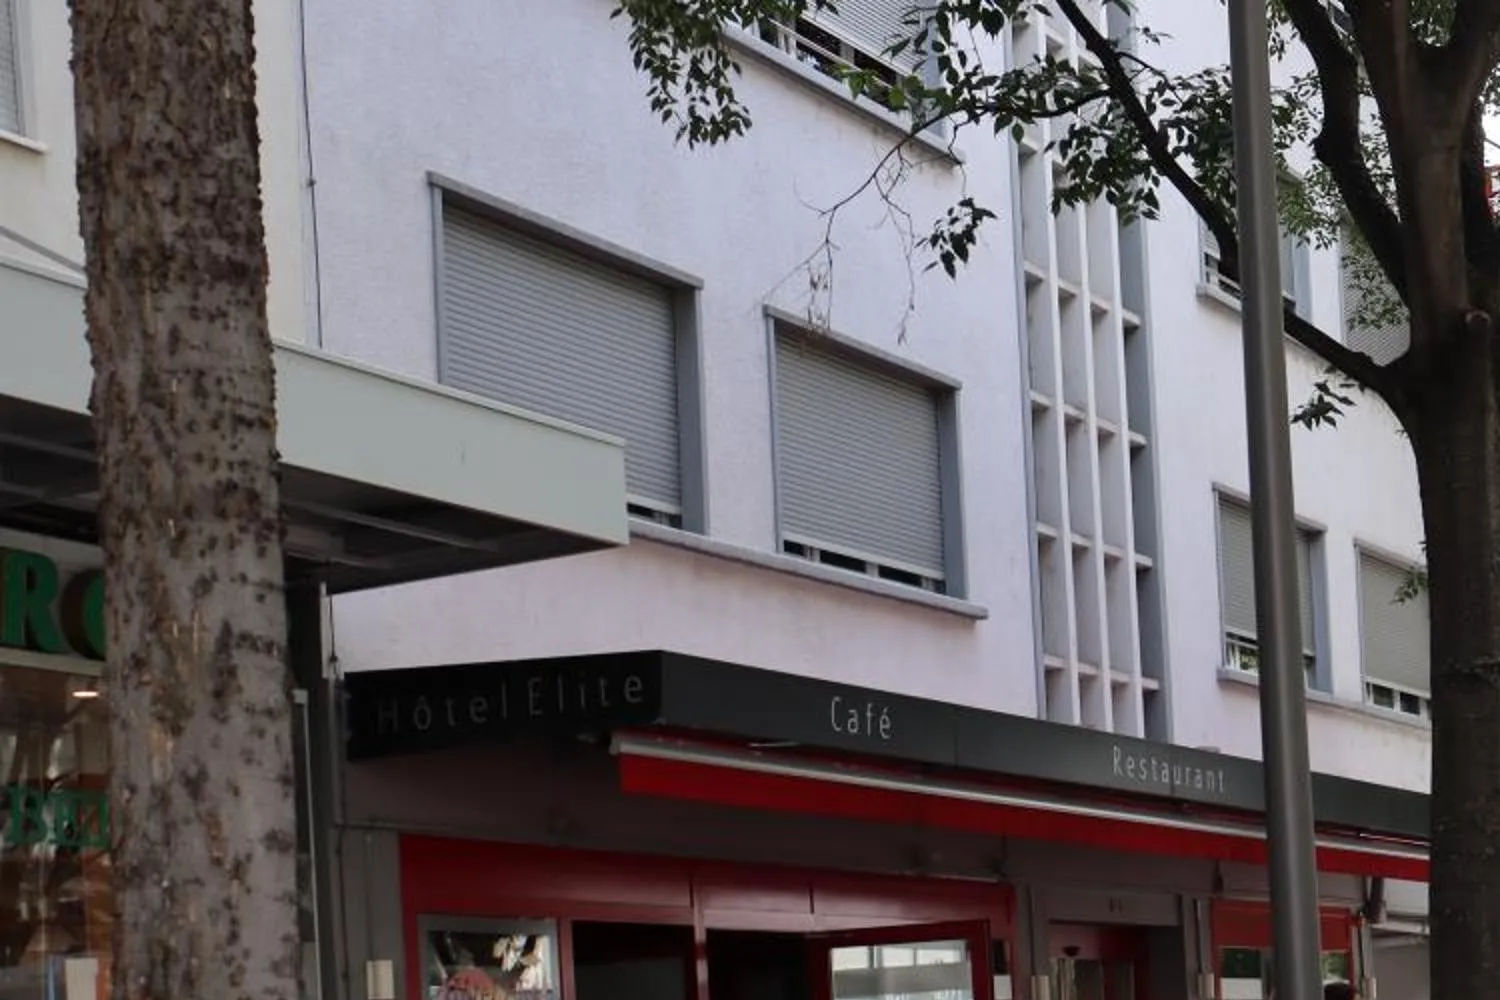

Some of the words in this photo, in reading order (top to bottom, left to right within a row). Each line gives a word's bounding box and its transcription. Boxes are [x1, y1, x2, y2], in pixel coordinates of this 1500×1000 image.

[527, 672, 644, 721] Elite
[831, 695, 892, 739] Café
[1112, 744, 1226, 793] Restaurant
